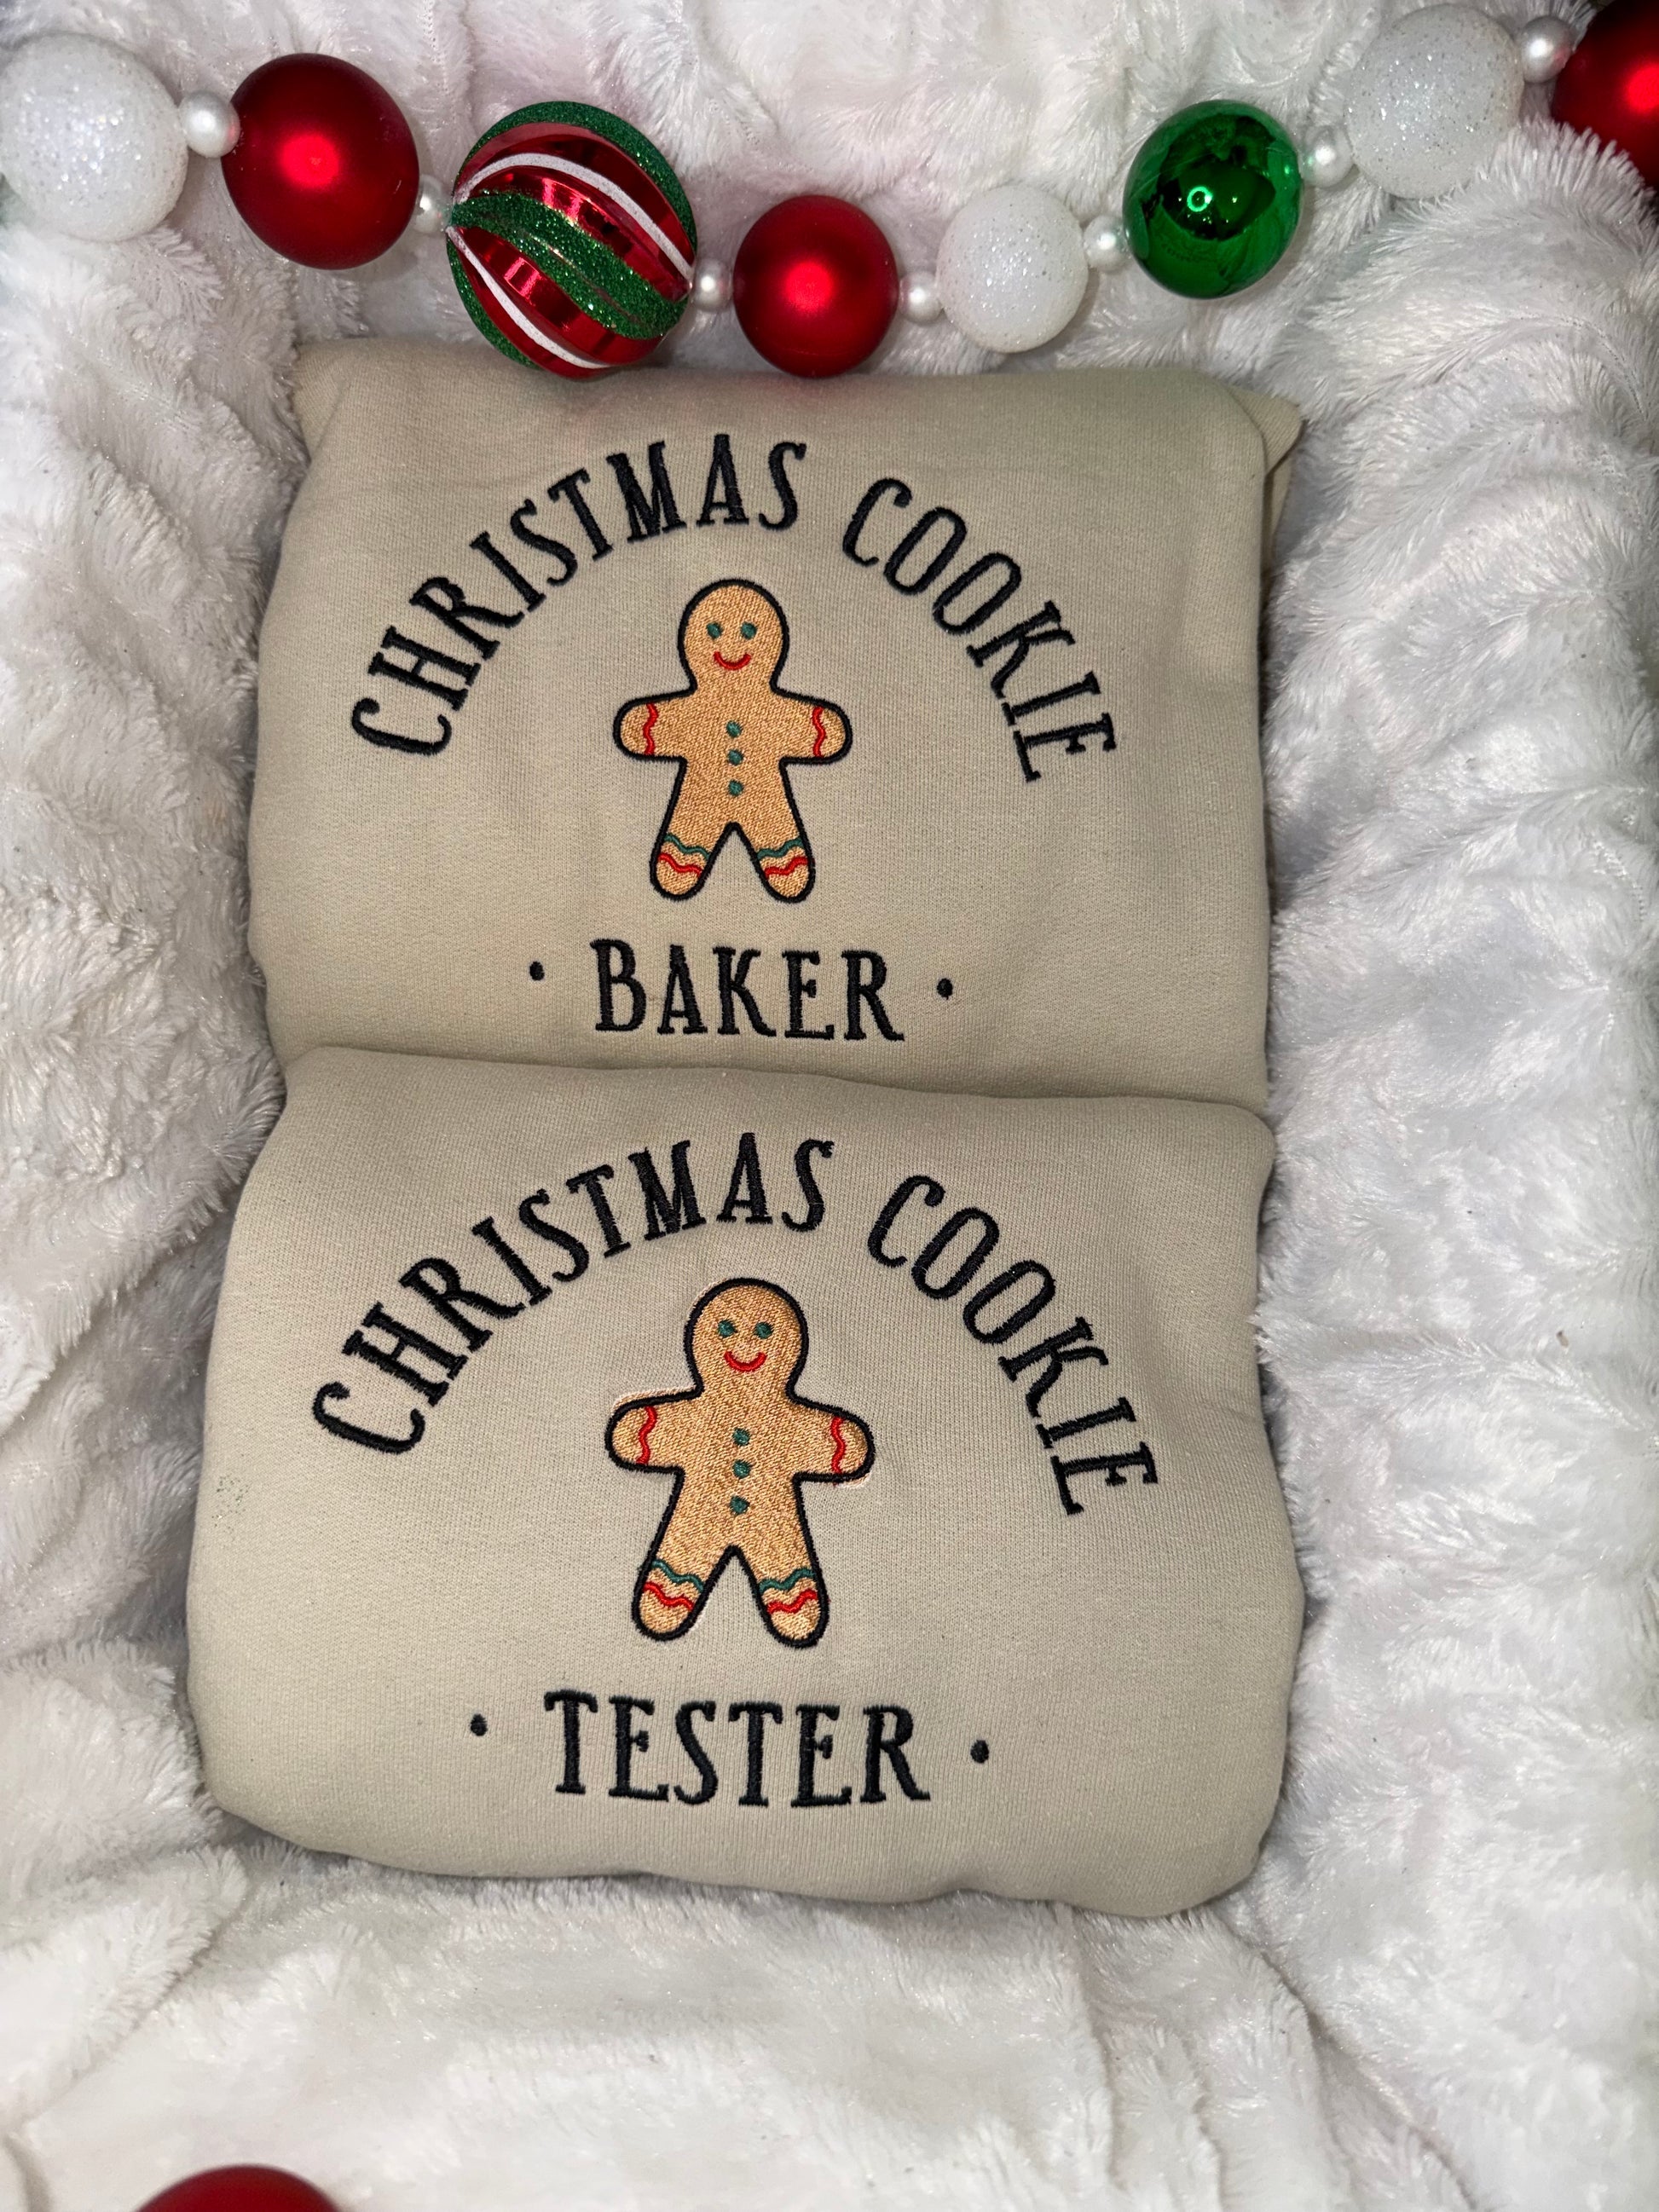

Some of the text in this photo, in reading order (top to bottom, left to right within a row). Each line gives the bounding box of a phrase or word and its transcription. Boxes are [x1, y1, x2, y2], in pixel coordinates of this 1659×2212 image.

[350, 432, 1119, 784] CHRISTMAS COOKIE
[588, 937, 906, 1043] BAKER
[310, 1131, 1160, 1517] CHRISTMAS COOKIE
[542, 1688, 932, 1810] TESTER
